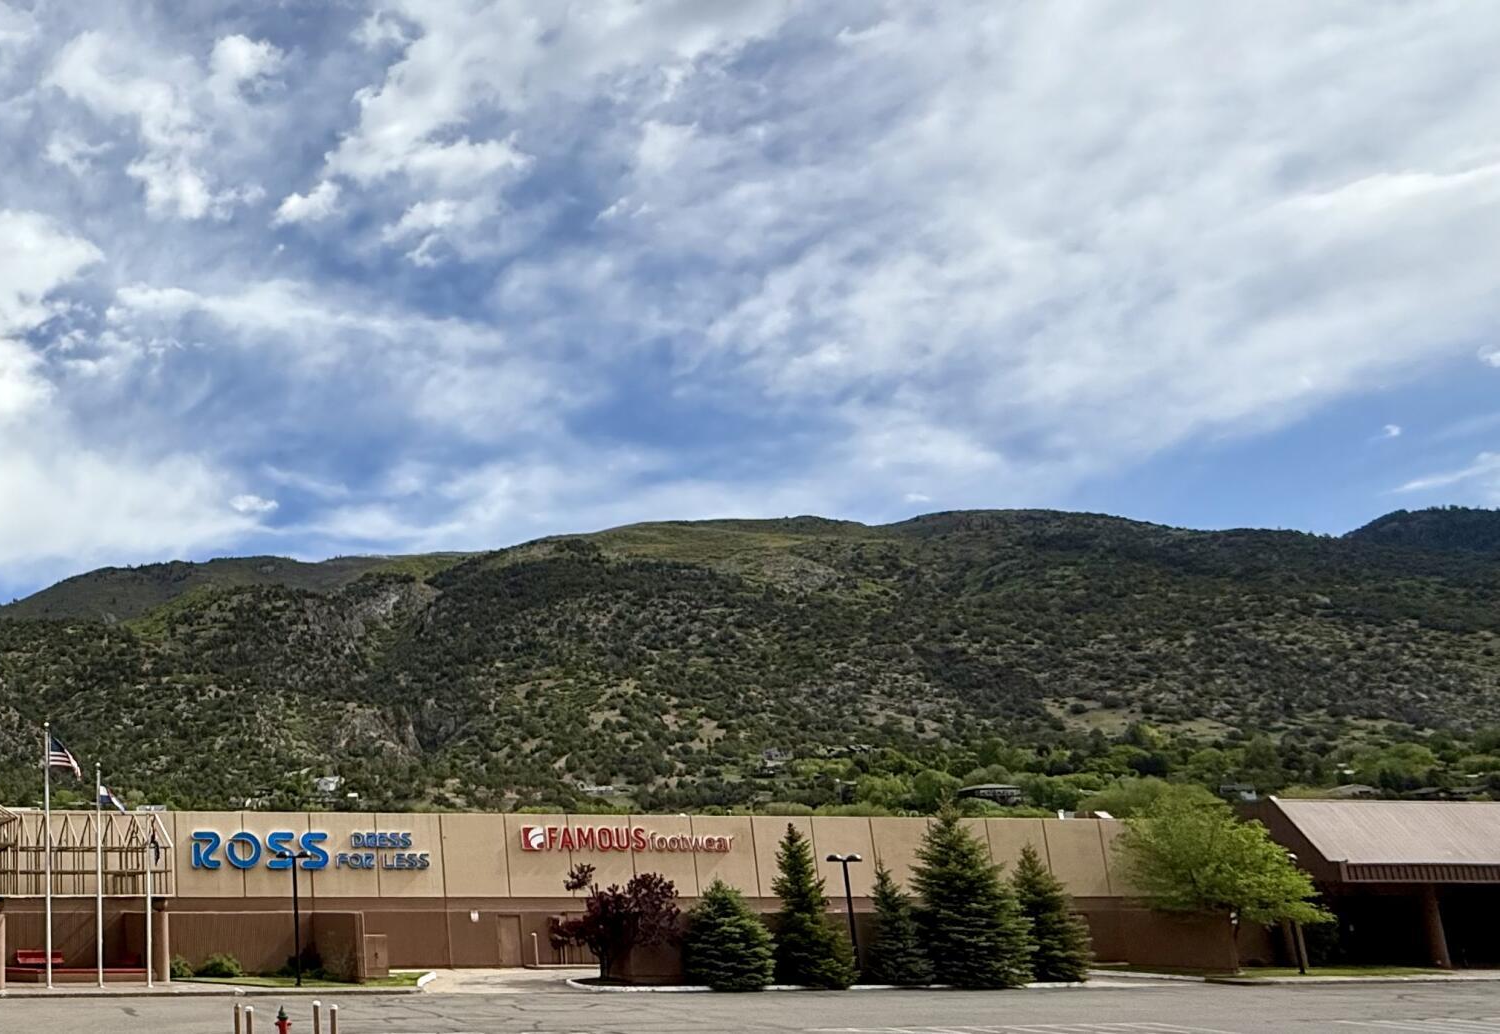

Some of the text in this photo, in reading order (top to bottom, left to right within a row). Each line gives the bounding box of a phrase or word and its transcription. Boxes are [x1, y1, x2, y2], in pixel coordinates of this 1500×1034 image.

[351, 832, 412, 848] DRESS
[546, 827, 734, 851] FAMOUS footwear
[191, 831, 329, 869] ROSS
[336, 853, 430, 869] FOR LESS
